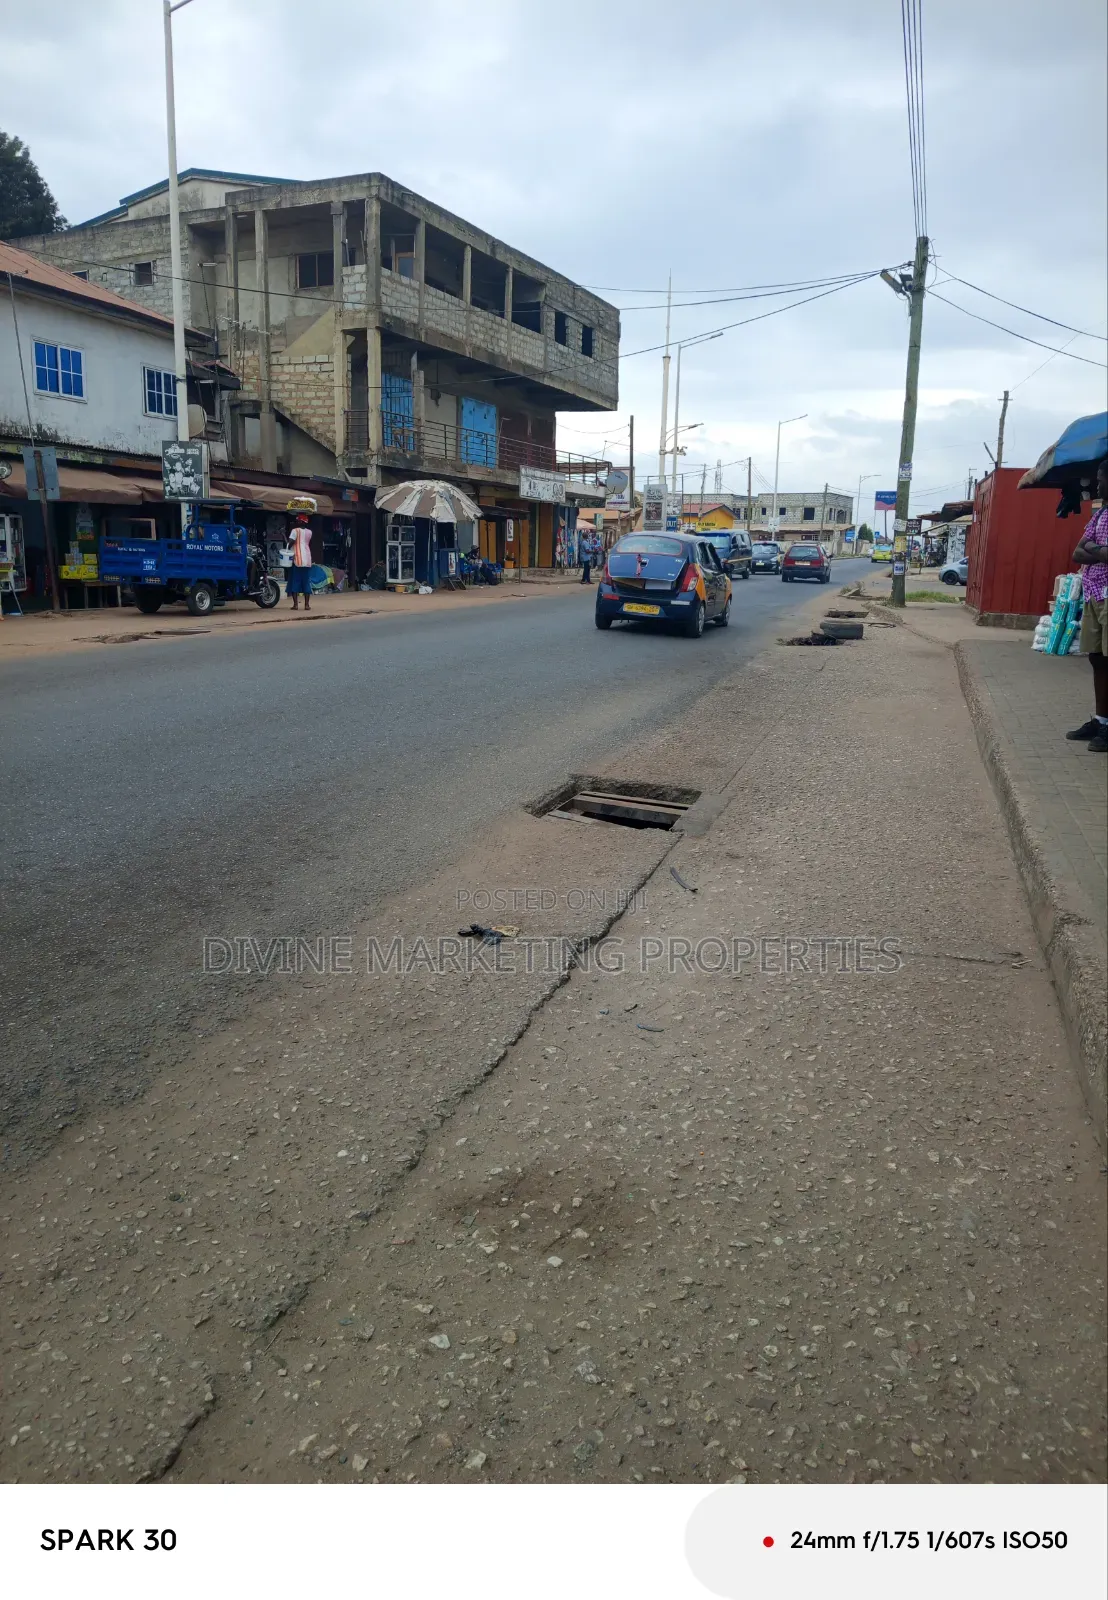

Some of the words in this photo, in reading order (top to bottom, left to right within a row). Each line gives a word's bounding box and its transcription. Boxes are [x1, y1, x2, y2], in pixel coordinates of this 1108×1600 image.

[666, 520, 677, 528] OUT
[186, 543, 203, 551] ROYAL
[204, 544, 224, 552] MOTORS
